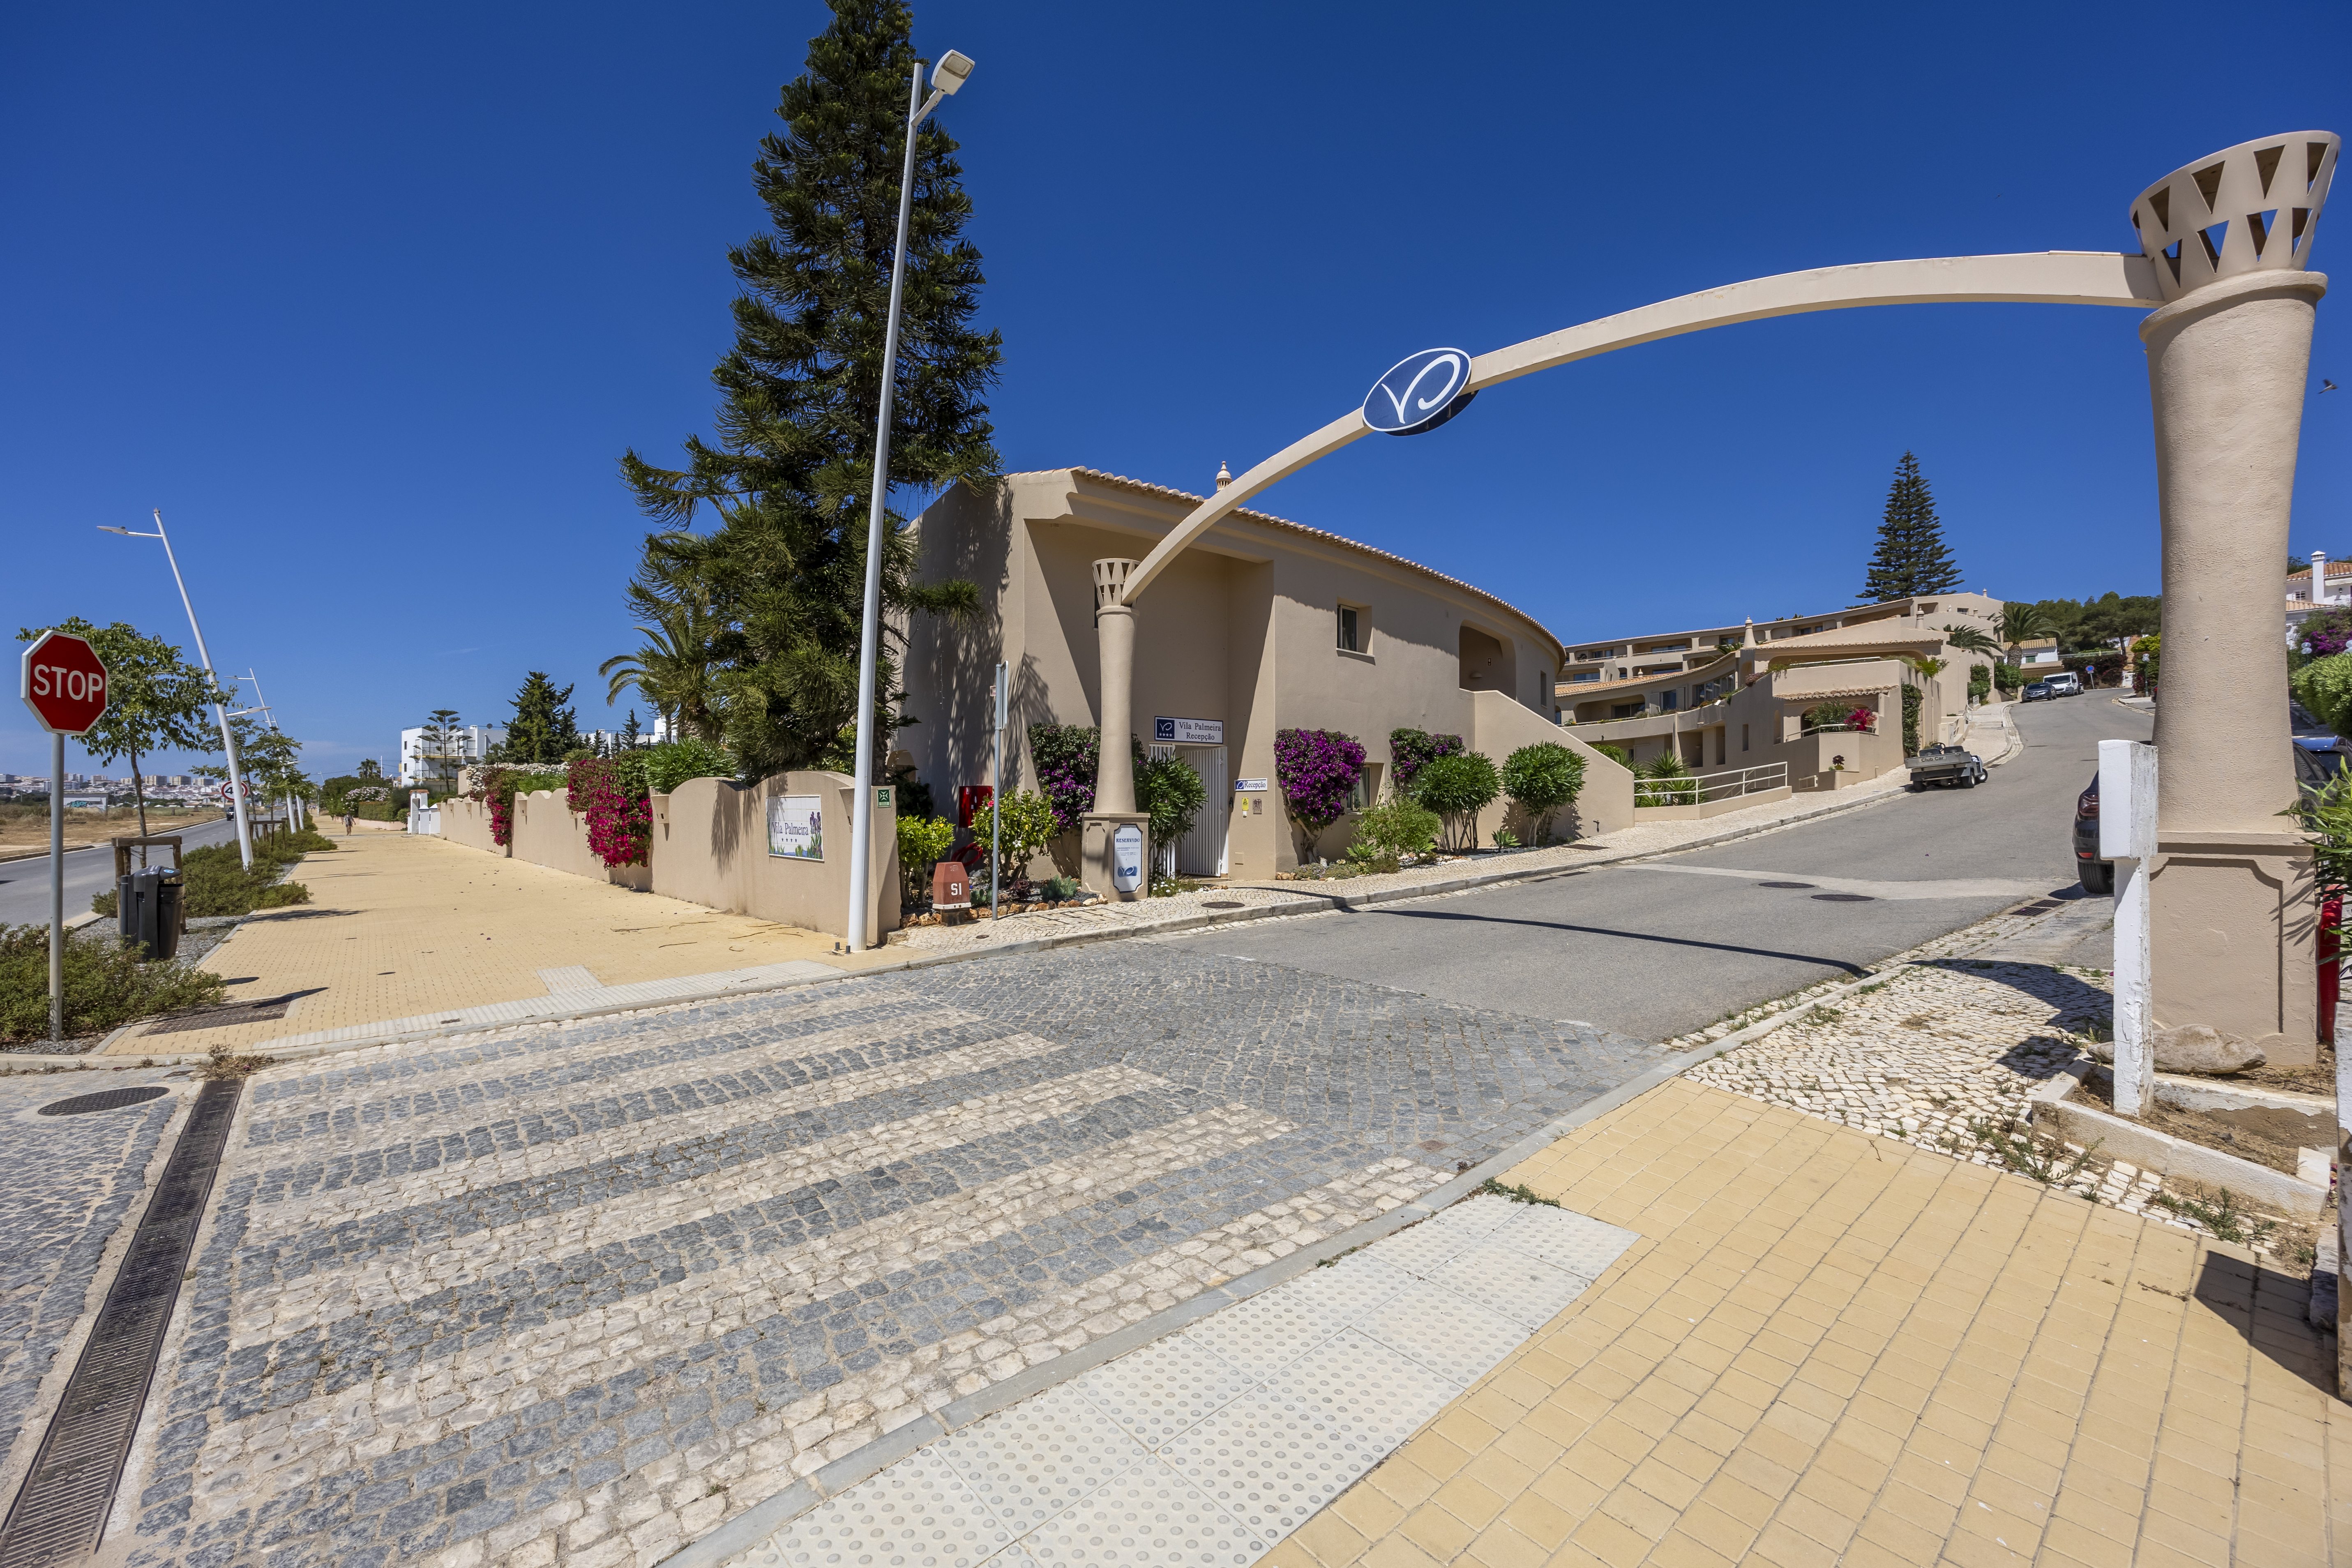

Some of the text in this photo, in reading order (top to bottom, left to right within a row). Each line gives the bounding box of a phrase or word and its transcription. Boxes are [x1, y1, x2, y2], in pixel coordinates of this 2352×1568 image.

[33, 664, 103, 702] STOP
[1178, 722, 1222, 731] Vila Palmeira
[1186, 732, 1215, 741] Recepção
[1244, 781, 1266, 789] Recepção
[772, 822, 809, 836] Vila Palmeira
